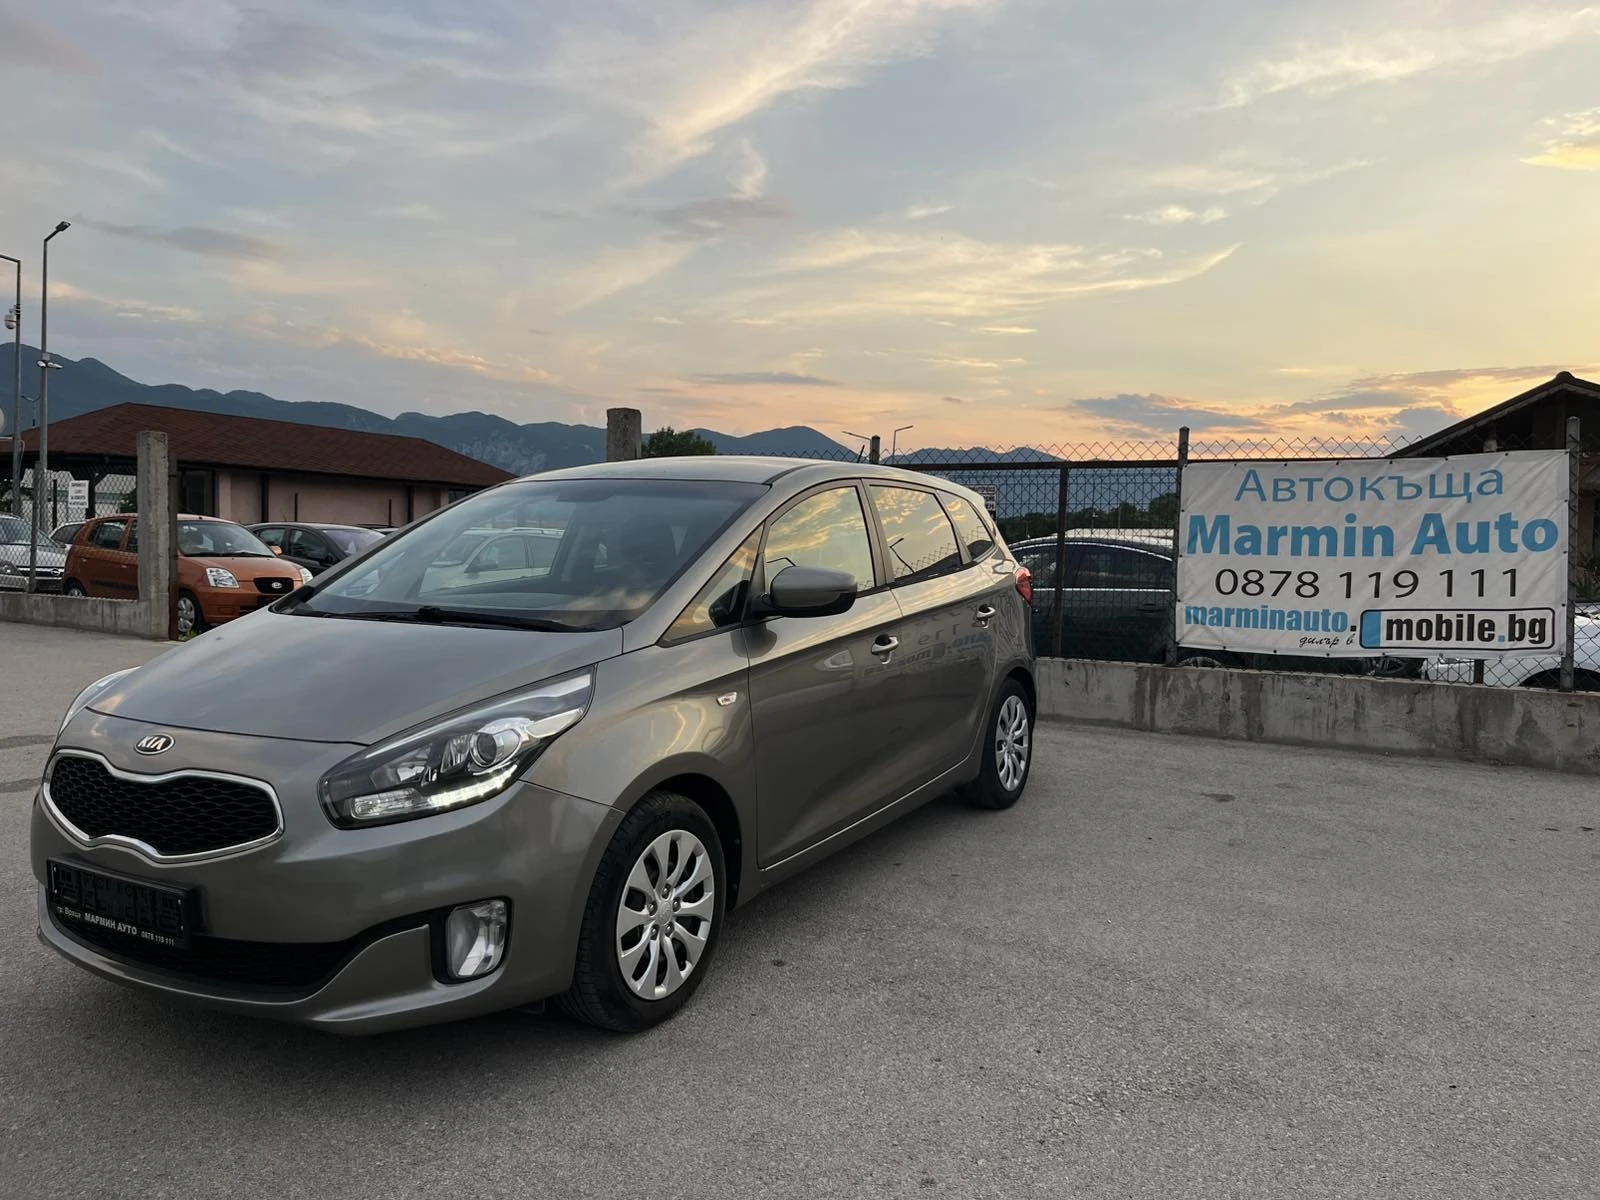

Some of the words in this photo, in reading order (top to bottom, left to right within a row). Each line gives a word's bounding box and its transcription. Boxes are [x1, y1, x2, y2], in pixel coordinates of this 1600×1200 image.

[1234, 468, 1504, 503] Автокъща
[1186, 513, 1394, 557] Marmin
[1410, 511, 1559, 555] Auto
[1215, 568, 1320, 598] 0878
[1340, 569, 1419, 599] 119
[1439, 568, 1518, 597] 111
[1386, 613, 1546, 645] mobile.bg
[137, 736, 167, 750] KIA
[84, 912, 116, 929] МАРМИН
[117, 922, 138, 935] АУТО
